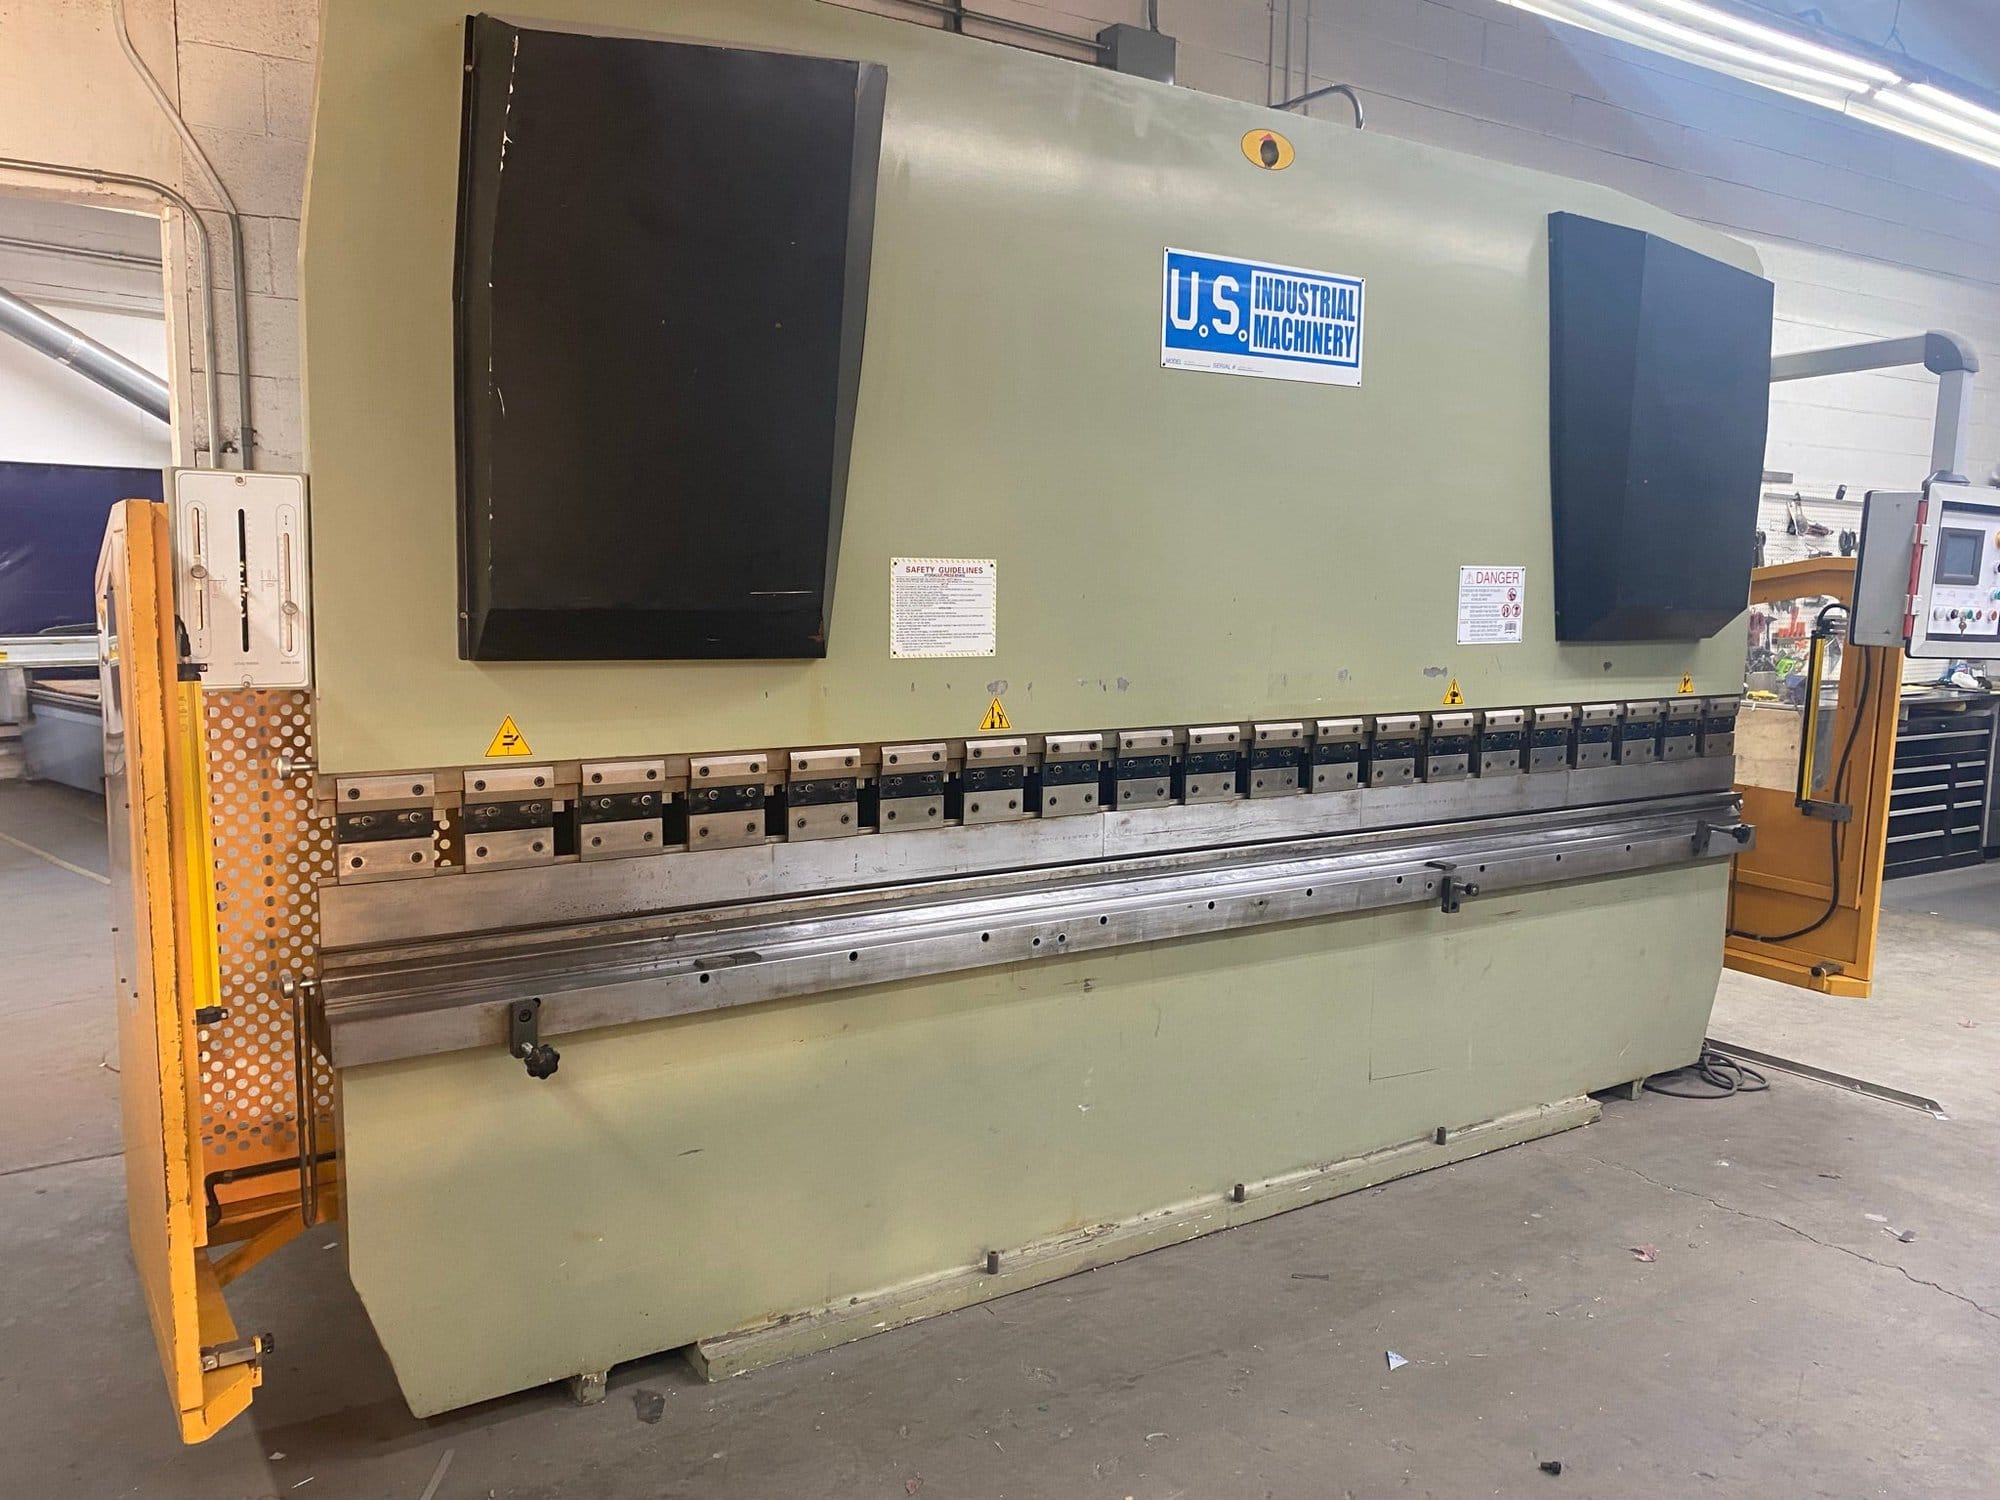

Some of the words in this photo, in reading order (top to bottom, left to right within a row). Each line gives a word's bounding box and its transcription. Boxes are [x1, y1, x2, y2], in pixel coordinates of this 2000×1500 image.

[1169, 268, 1248, 342] U.S.
[1254, 275, 1355, 322] INDUSTRIAL
[1253, 314, 1356, 358] MACHINERY
[905, 566, 935, 574] SAFETY
[938, 566, 984, 574] GUIDELINES
[1476, 571, 1520, 584] DANGER
